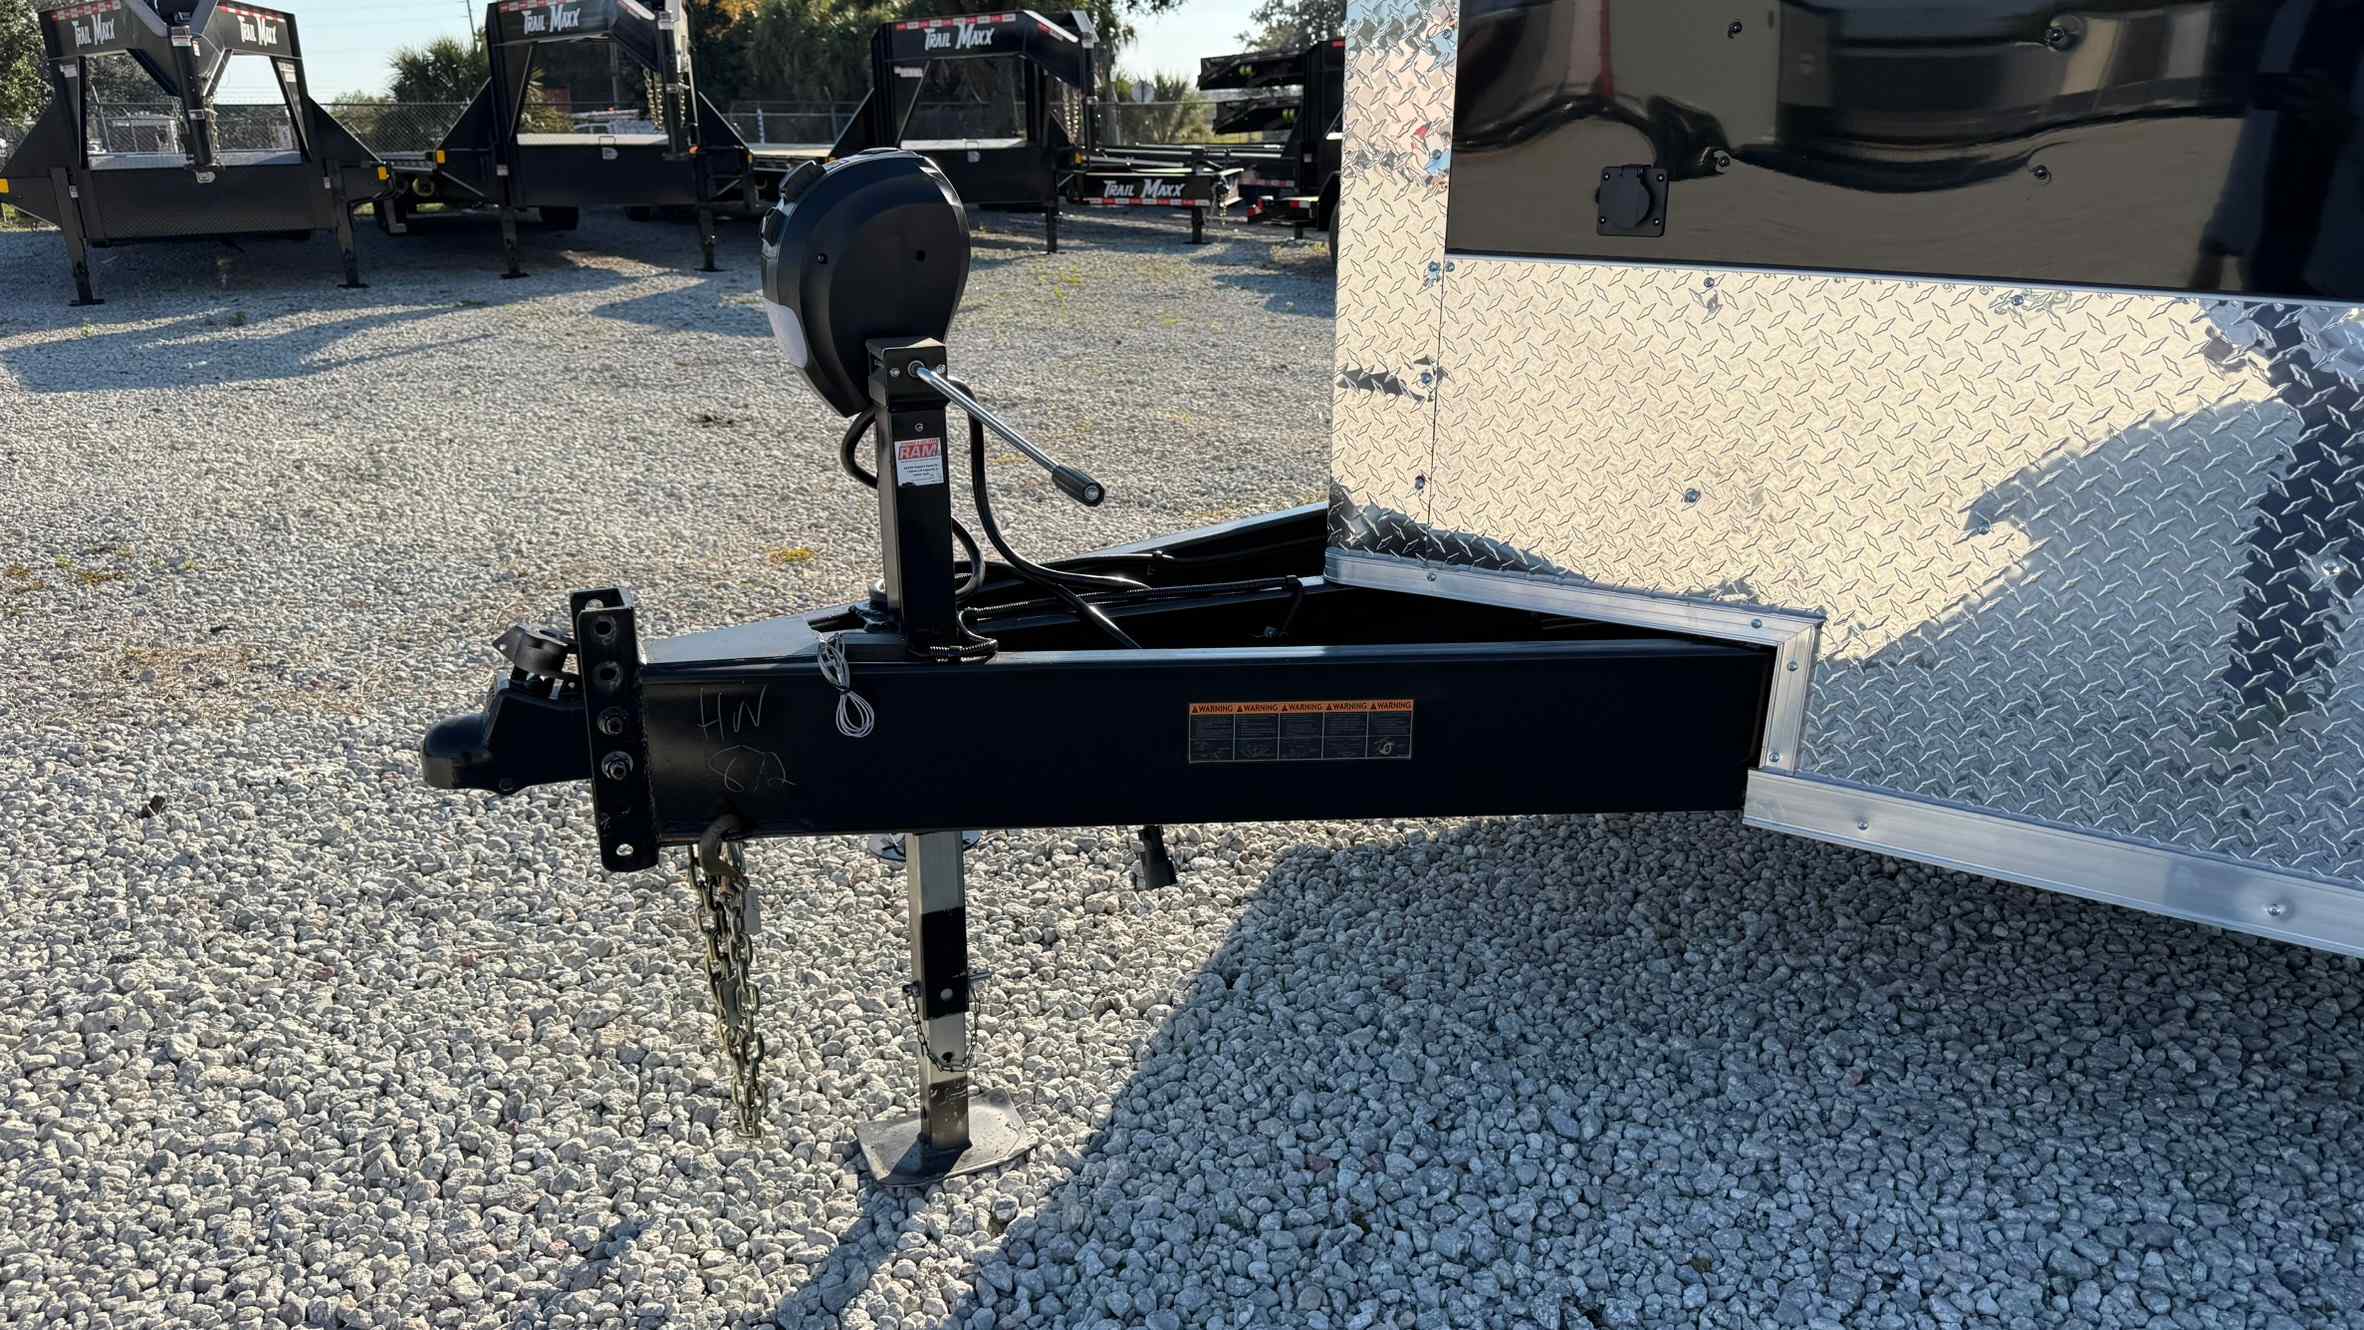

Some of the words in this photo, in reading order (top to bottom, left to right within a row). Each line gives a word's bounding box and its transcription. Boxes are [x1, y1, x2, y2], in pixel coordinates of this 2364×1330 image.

[1140, 178, 1185, 198] MAXX
[898, 444, 939, 460] RAM
[1198, 704, 1234, 713] WARNING
[1243, 704, 1279, 713] WARNING
[1288, 703, 1323, 712] WARNING
[1332, 702, 1368, 711] WARNING
[1376, 701, 1413, 710] WARNING
